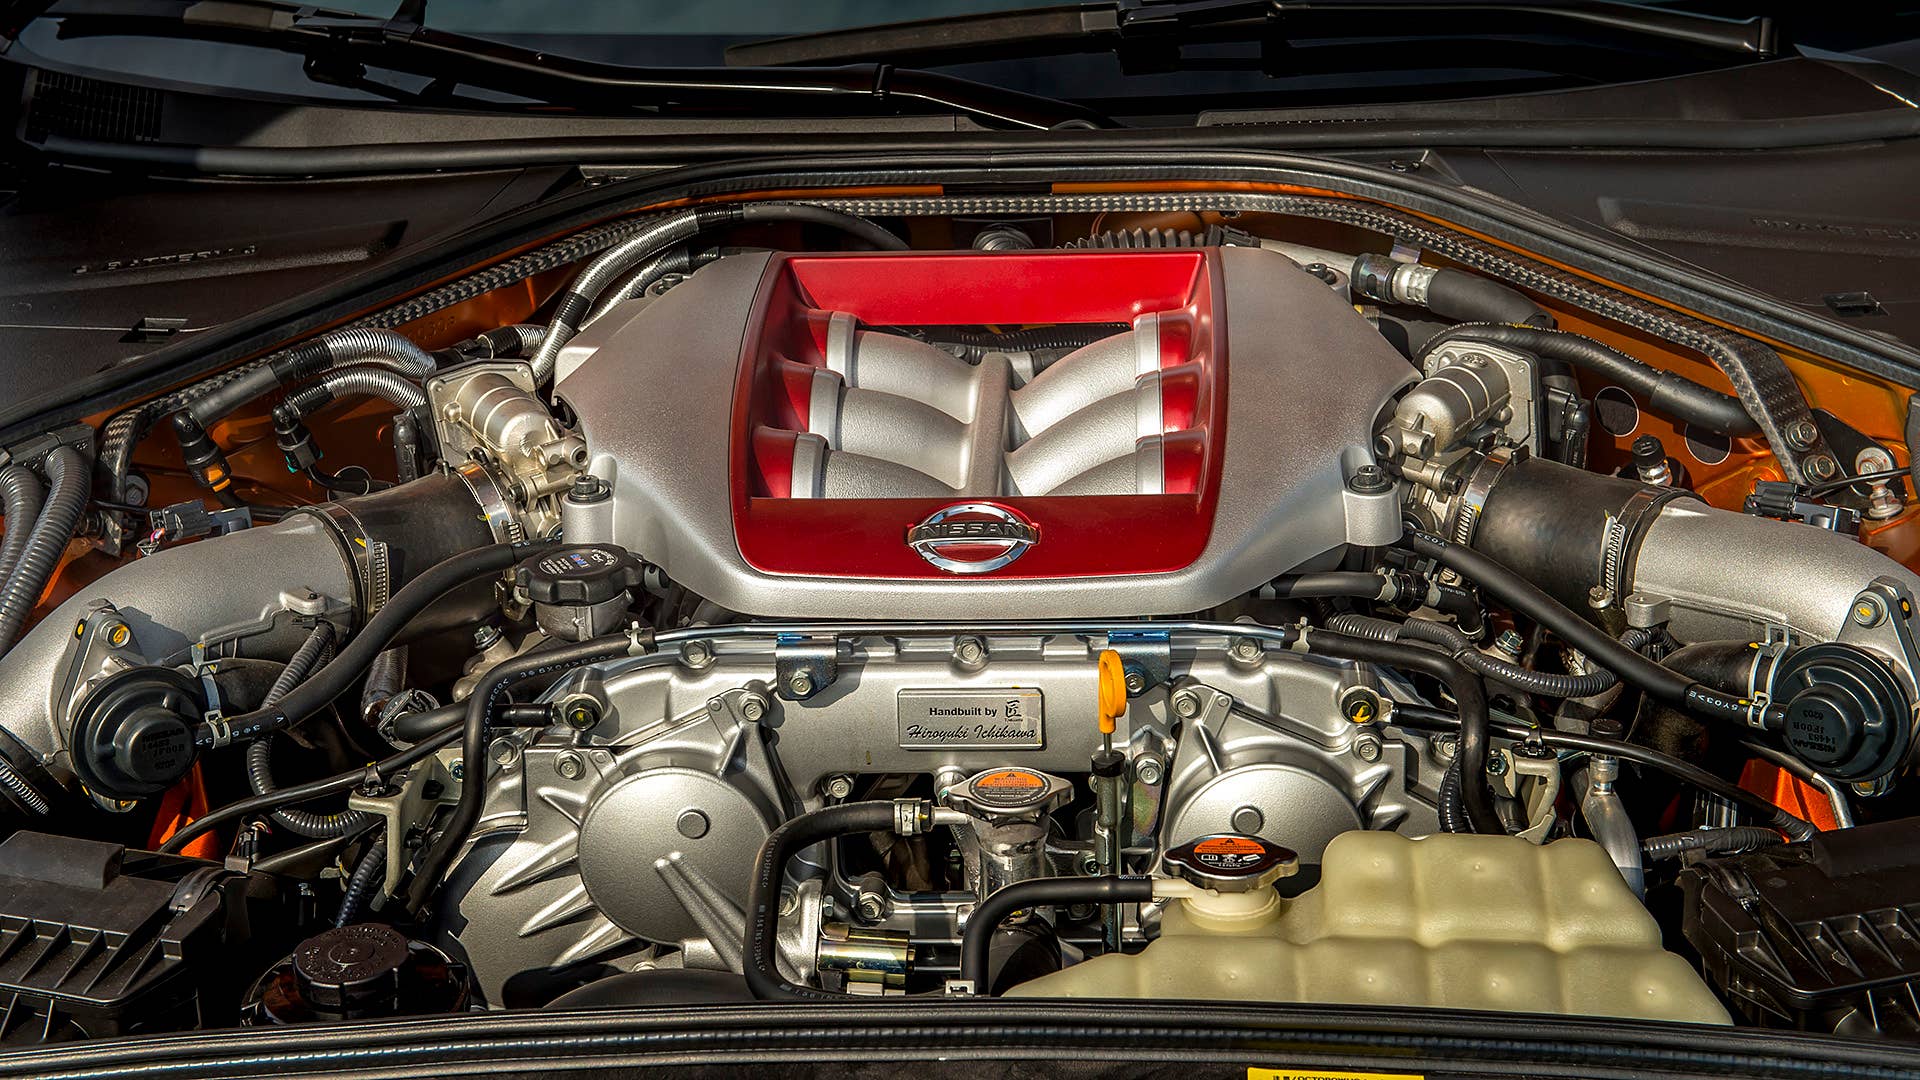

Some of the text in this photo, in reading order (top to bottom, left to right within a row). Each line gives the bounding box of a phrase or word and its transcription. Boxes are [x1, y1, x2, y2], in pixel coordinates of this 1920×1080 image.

[921, 522, 1024, 538] NISSAN
[929, 707, 998, 718] Handbuilt by
[906, 724, 1037, 743] Hiroyuki Ichikawa
